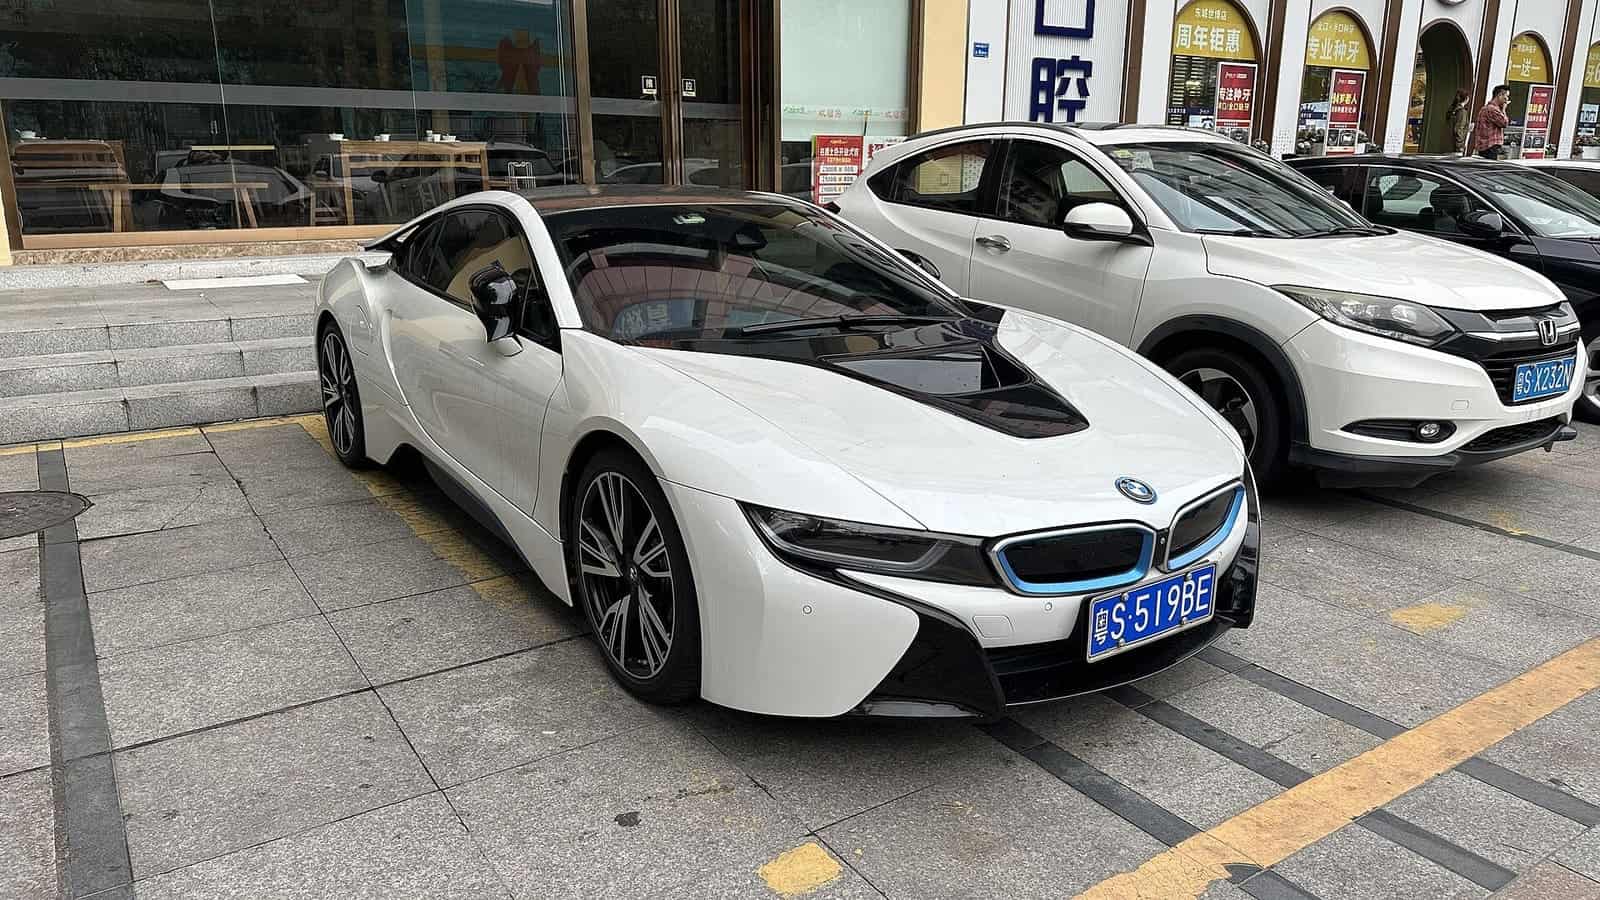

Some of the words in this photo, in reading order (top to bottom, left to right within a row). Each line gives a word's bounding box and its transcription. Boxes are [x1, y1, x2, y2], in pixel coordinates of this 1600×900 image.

[1029, 0, 1095, 122] 口腔
[1176, 24, 1240, 52] 周年钜惠
[1308, 36, 1360, 63] 专业种牙
[1094, 573, 1212, 646] 粤S·519BE
